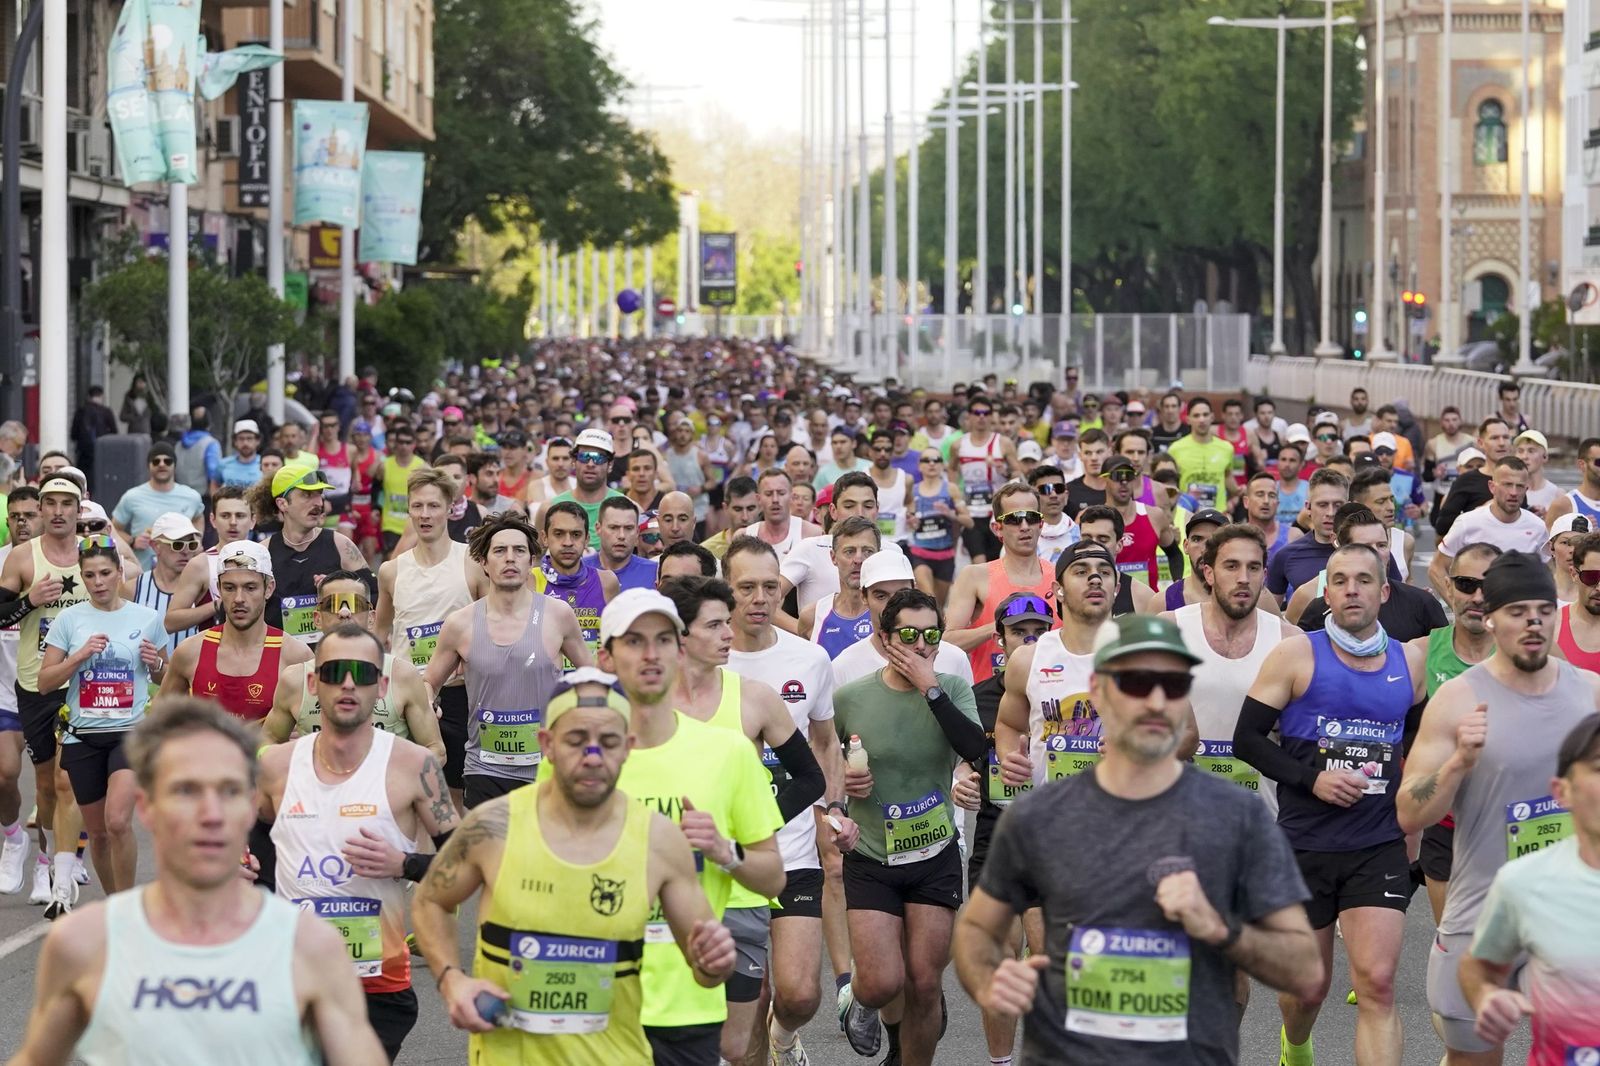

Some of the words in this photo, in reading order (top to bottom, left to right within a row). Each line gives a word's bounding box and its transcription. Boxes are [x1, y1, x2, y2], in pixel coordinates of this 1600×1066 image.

[246, 71, 267, 179] ENTOFT
[298, 622, 317, 632] JH
[424, 625, 441, 635] ZUR
[428, 641, 437, 649] 23
[412, 656, 427, 665] PER
[97, 671, 128, 680] ZURICH
[93, 696, 120, 707] JANA
[497, 713, 533, 723] ZURICH
[499, 731, 518, 739] 2917
[1346, 725, 1386, 738] ZURICH
[494, 741, 526, 753] OLLIE
[1070, 740, 1101, 750] ZURIC
[1210, 744, 1233, 754] ZUR
[762, 752, 779, 761] RIC
[1345, 746, 1368, 758] 3728
[1211, 763, 1233, 773] 2838
[905, 795, 938, 815] ZURICH
[1535, 800, 1560, 814] ZUR
[910, 819, 930, 832] 1656
[1536, 822, 1562, 836] 2857
[893, 824, 948, 852] RODRIGO
[321, 902, 370, 914] ZURICH
[1109, 934, 1176, 954] ZURICH
[545, 943, 606, 959] ZURICH
[545, 972, 576, 986] 2503
[1110, 968, 1146, 984] 2754
[133, 977, 259, 1012] HOKA
[529, 990, 588, 1010] RICAR
[1068, 987, 1112, 1009] TOM
[1119, 993, 1188, 1015] POUSS
